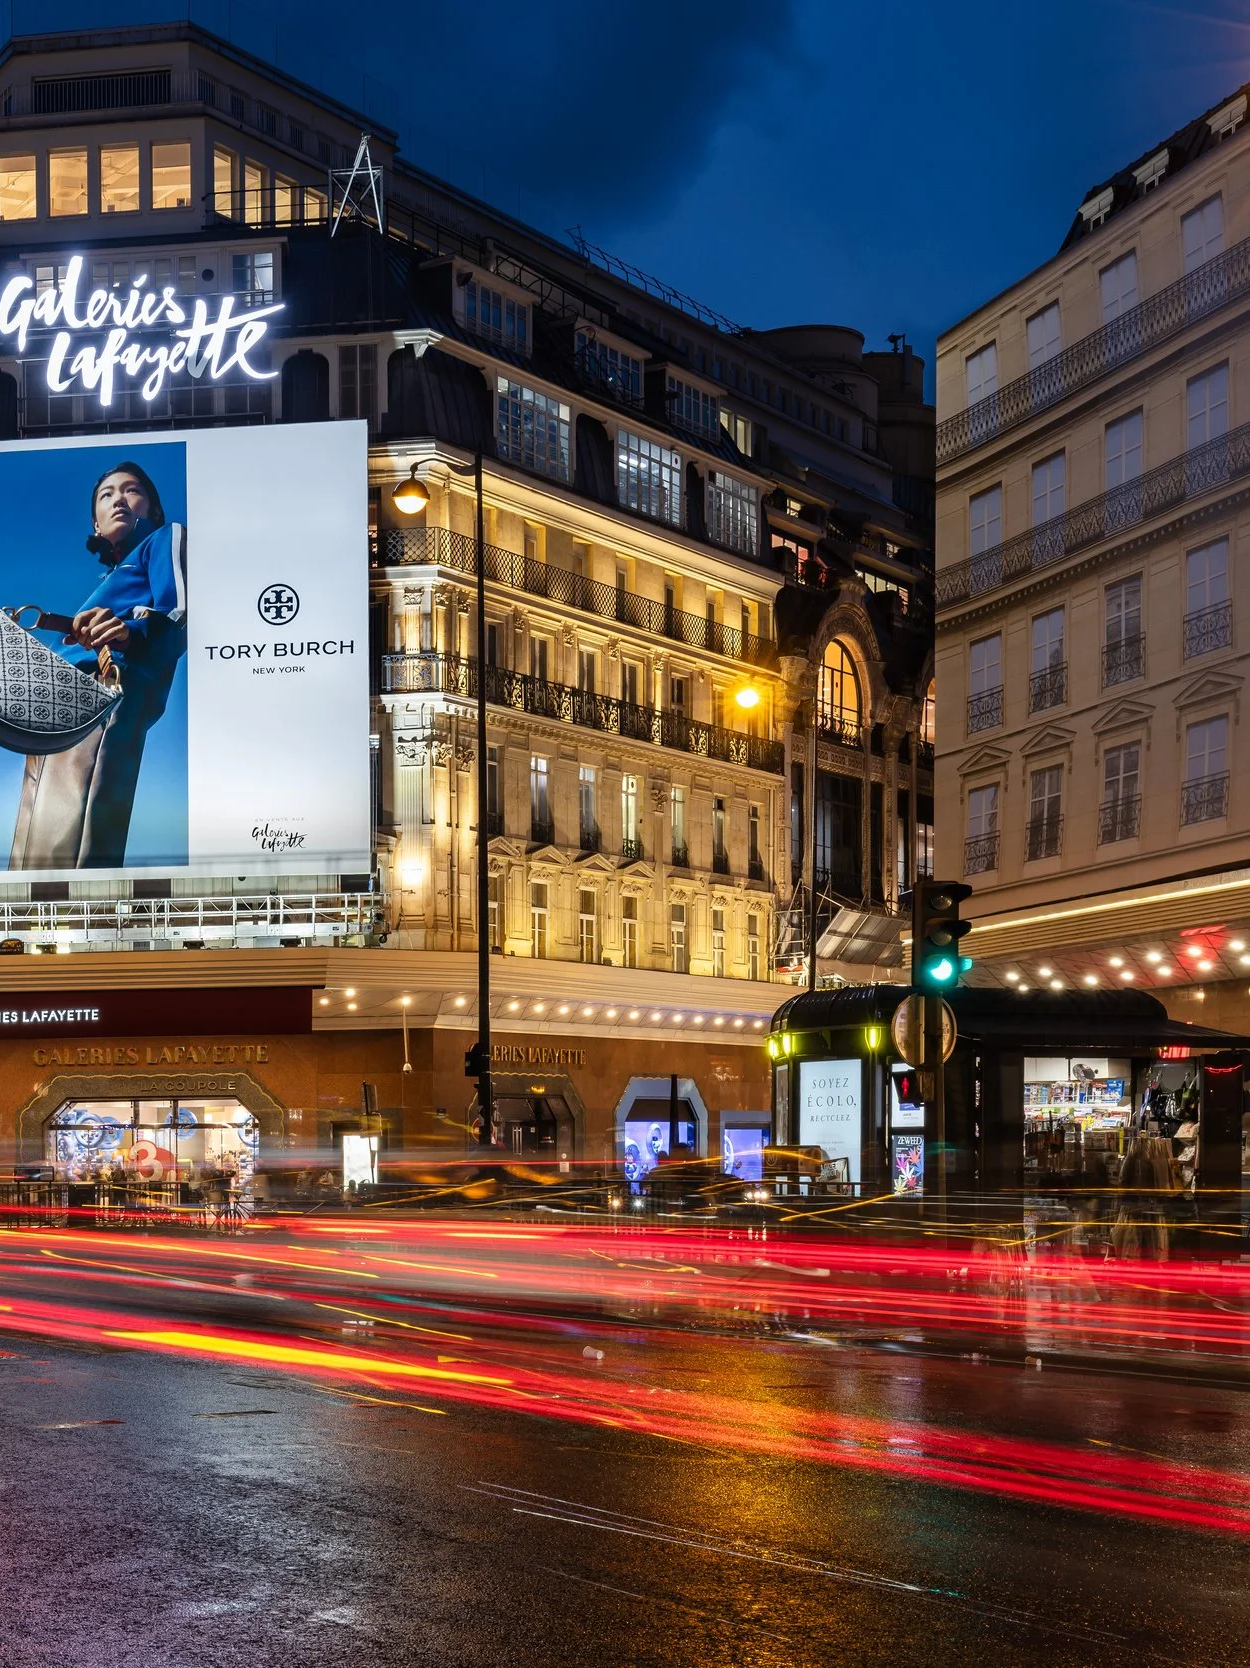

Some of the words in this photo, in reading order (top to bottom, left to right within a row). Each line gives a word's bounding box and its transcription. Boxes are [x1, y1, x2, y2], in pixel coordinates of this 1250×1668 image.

[46, 296, 286, 407] Lafayette
[205, 644, 267, 660] TORY
[274, 640, 354, 657] BURCH
[252, 667, 275, 675] NEW
[22, 1009, 99, 1023] LAFAYETTE
[33, 1047, 139, 1067] GALERIES
[146, 1045, 269, 1065] LAFAYETTE
[491, 1045, 526, 1062] ERIES
[528, 1047, 586, 1065] LAFAYETTE
[141, 1082, 159, 1092] LA
[166, 1081, 237, 1092] COUPOLE
[812, 1077, 849, 1089] SOYEZ
[807, 1094, 857, 1108] ÉCOLO,
[810, 1114, 851, 1122] RECYCLEZ
[897, 1136, 922, 1145] ZEWEED
